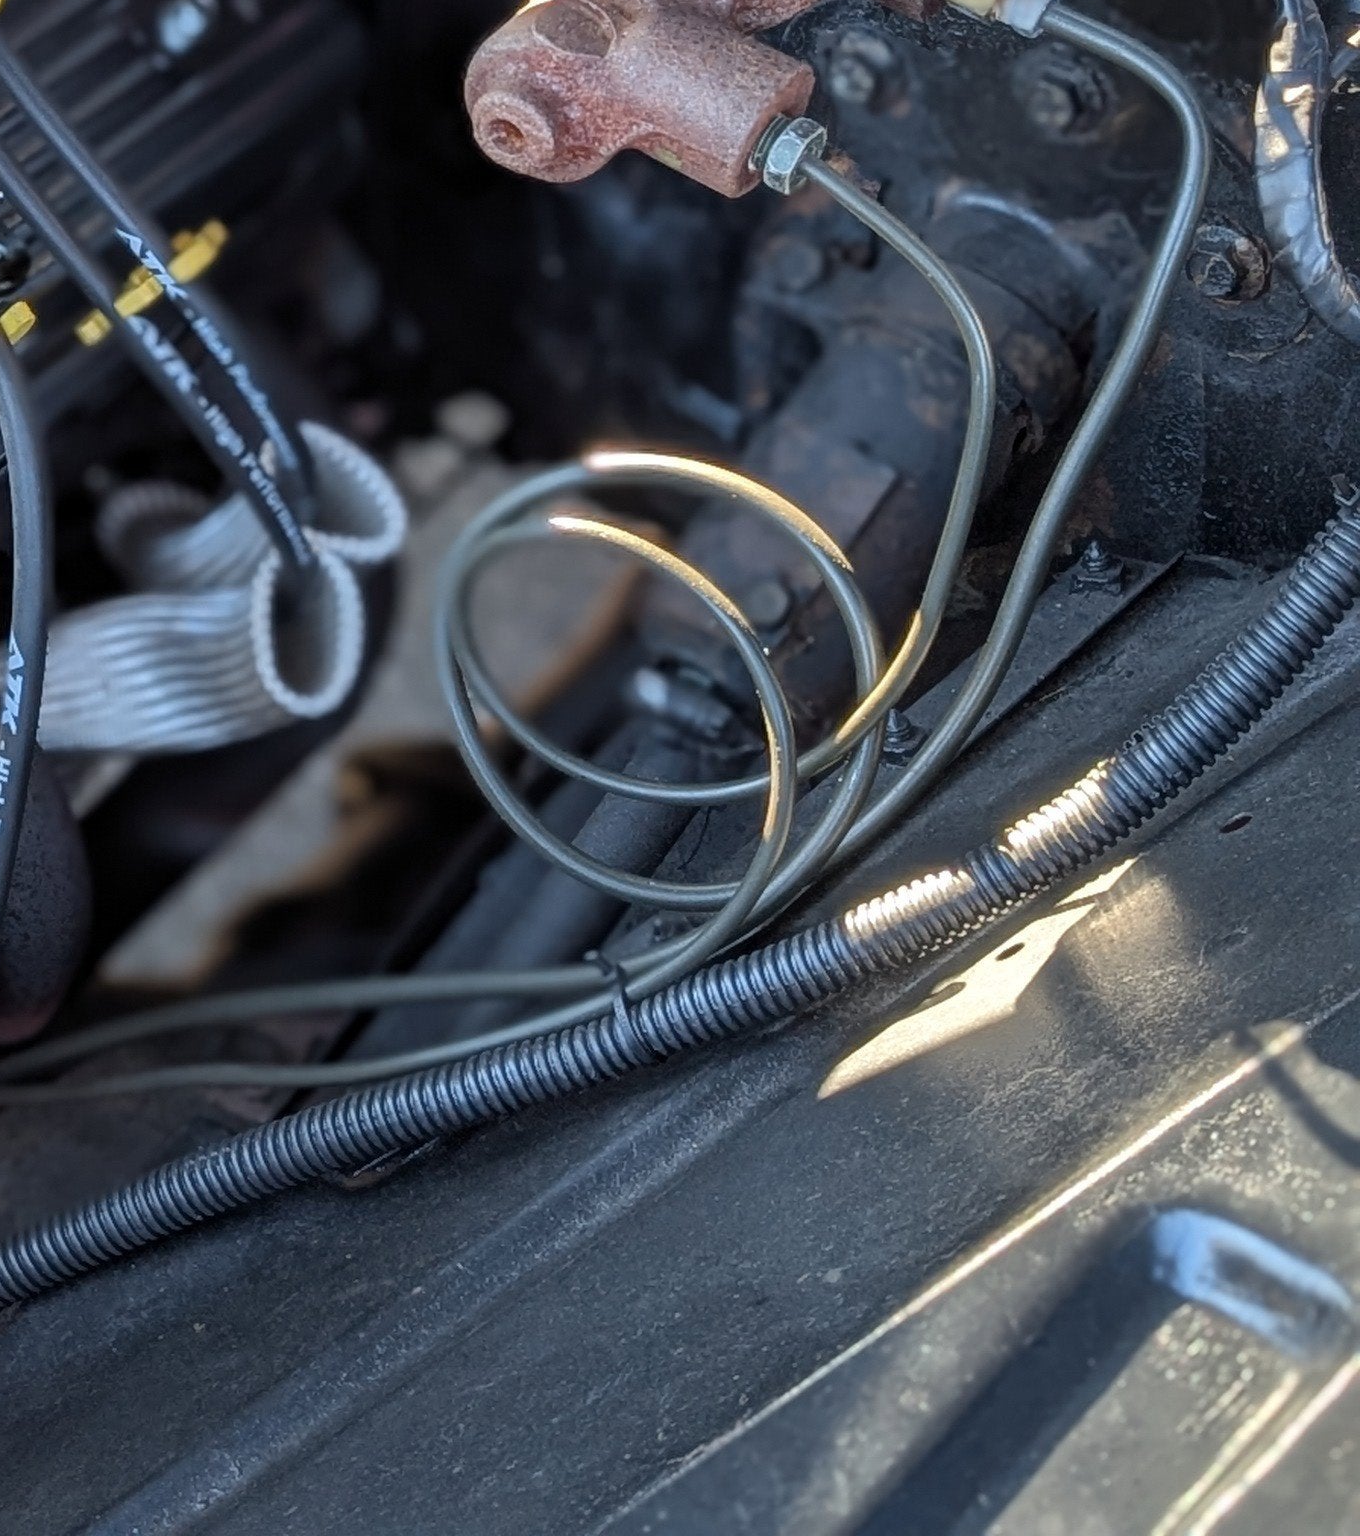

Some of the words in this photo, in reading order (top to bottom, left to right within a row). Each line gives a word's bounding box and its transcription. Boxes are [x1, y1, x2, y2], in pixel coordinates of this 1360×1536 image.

[114, 227, 189, 302] ATK
[204, 404, 246, 457] High
[2, 630, 25, 735] ATK
